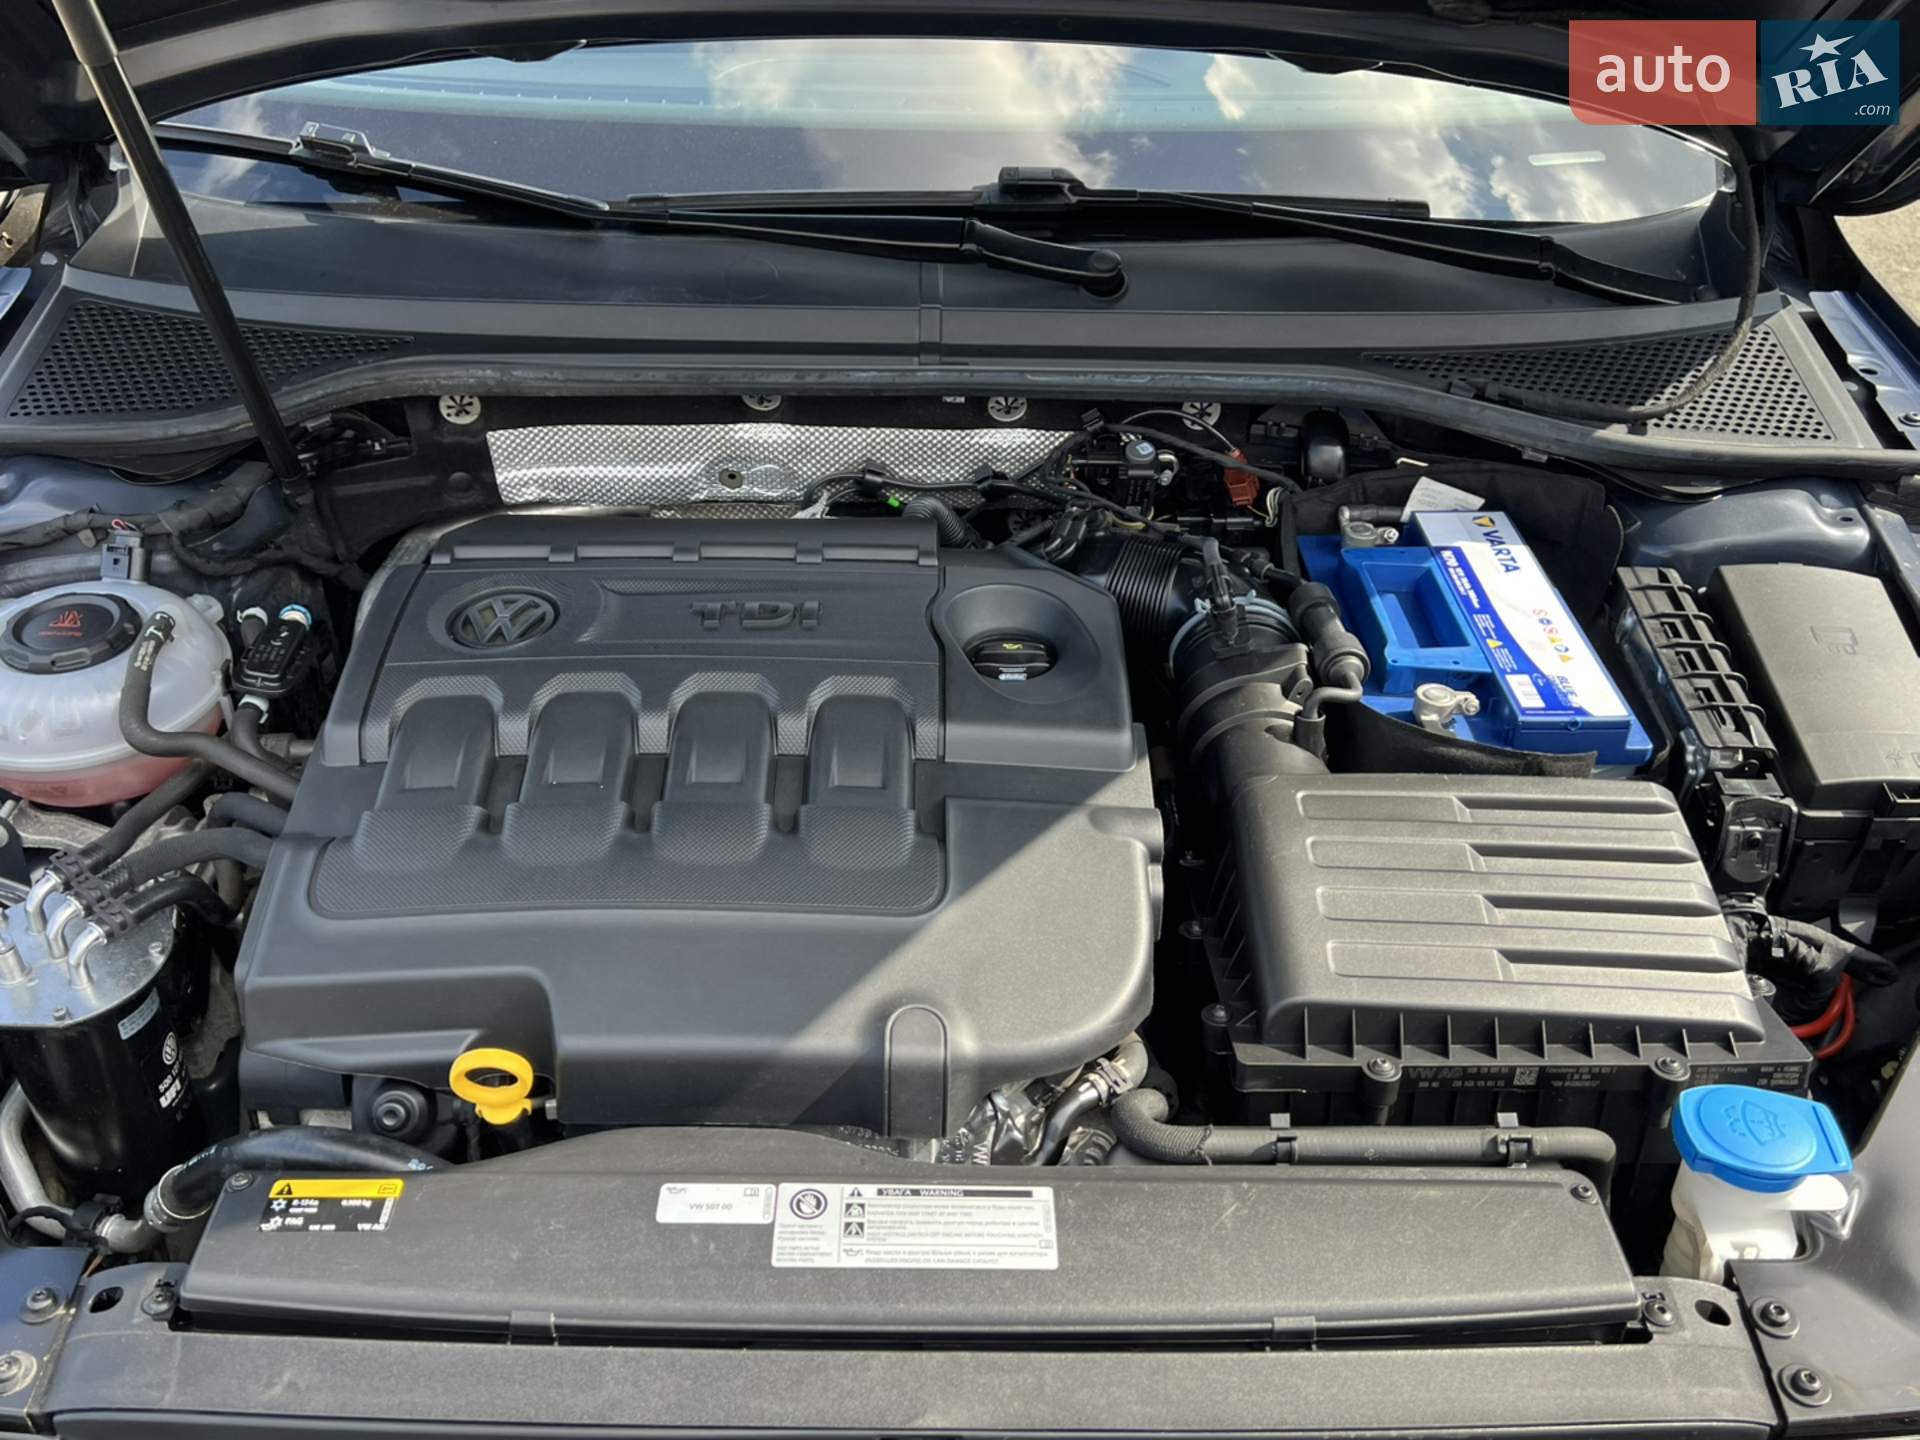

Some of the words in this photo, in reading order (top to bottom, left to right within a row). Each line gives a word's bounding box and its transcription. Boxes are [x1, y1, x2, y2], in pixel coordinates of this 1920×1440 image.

[1482, 529, 1521, 573] VARTA
[690, 601, 824, 630] TDI
[1408, 1067, 1437, 1079] VW
[1437, 1067, 1464, 1079] AG
[159, 1078, 182, 1108] UFI
[881, 1188, 912, 1196] УВАГА
[919, 1188, 964, 1197] WARNING
[284, 1217, 304, 1226] PAG
[357, 1223, 372, 1231] VW
